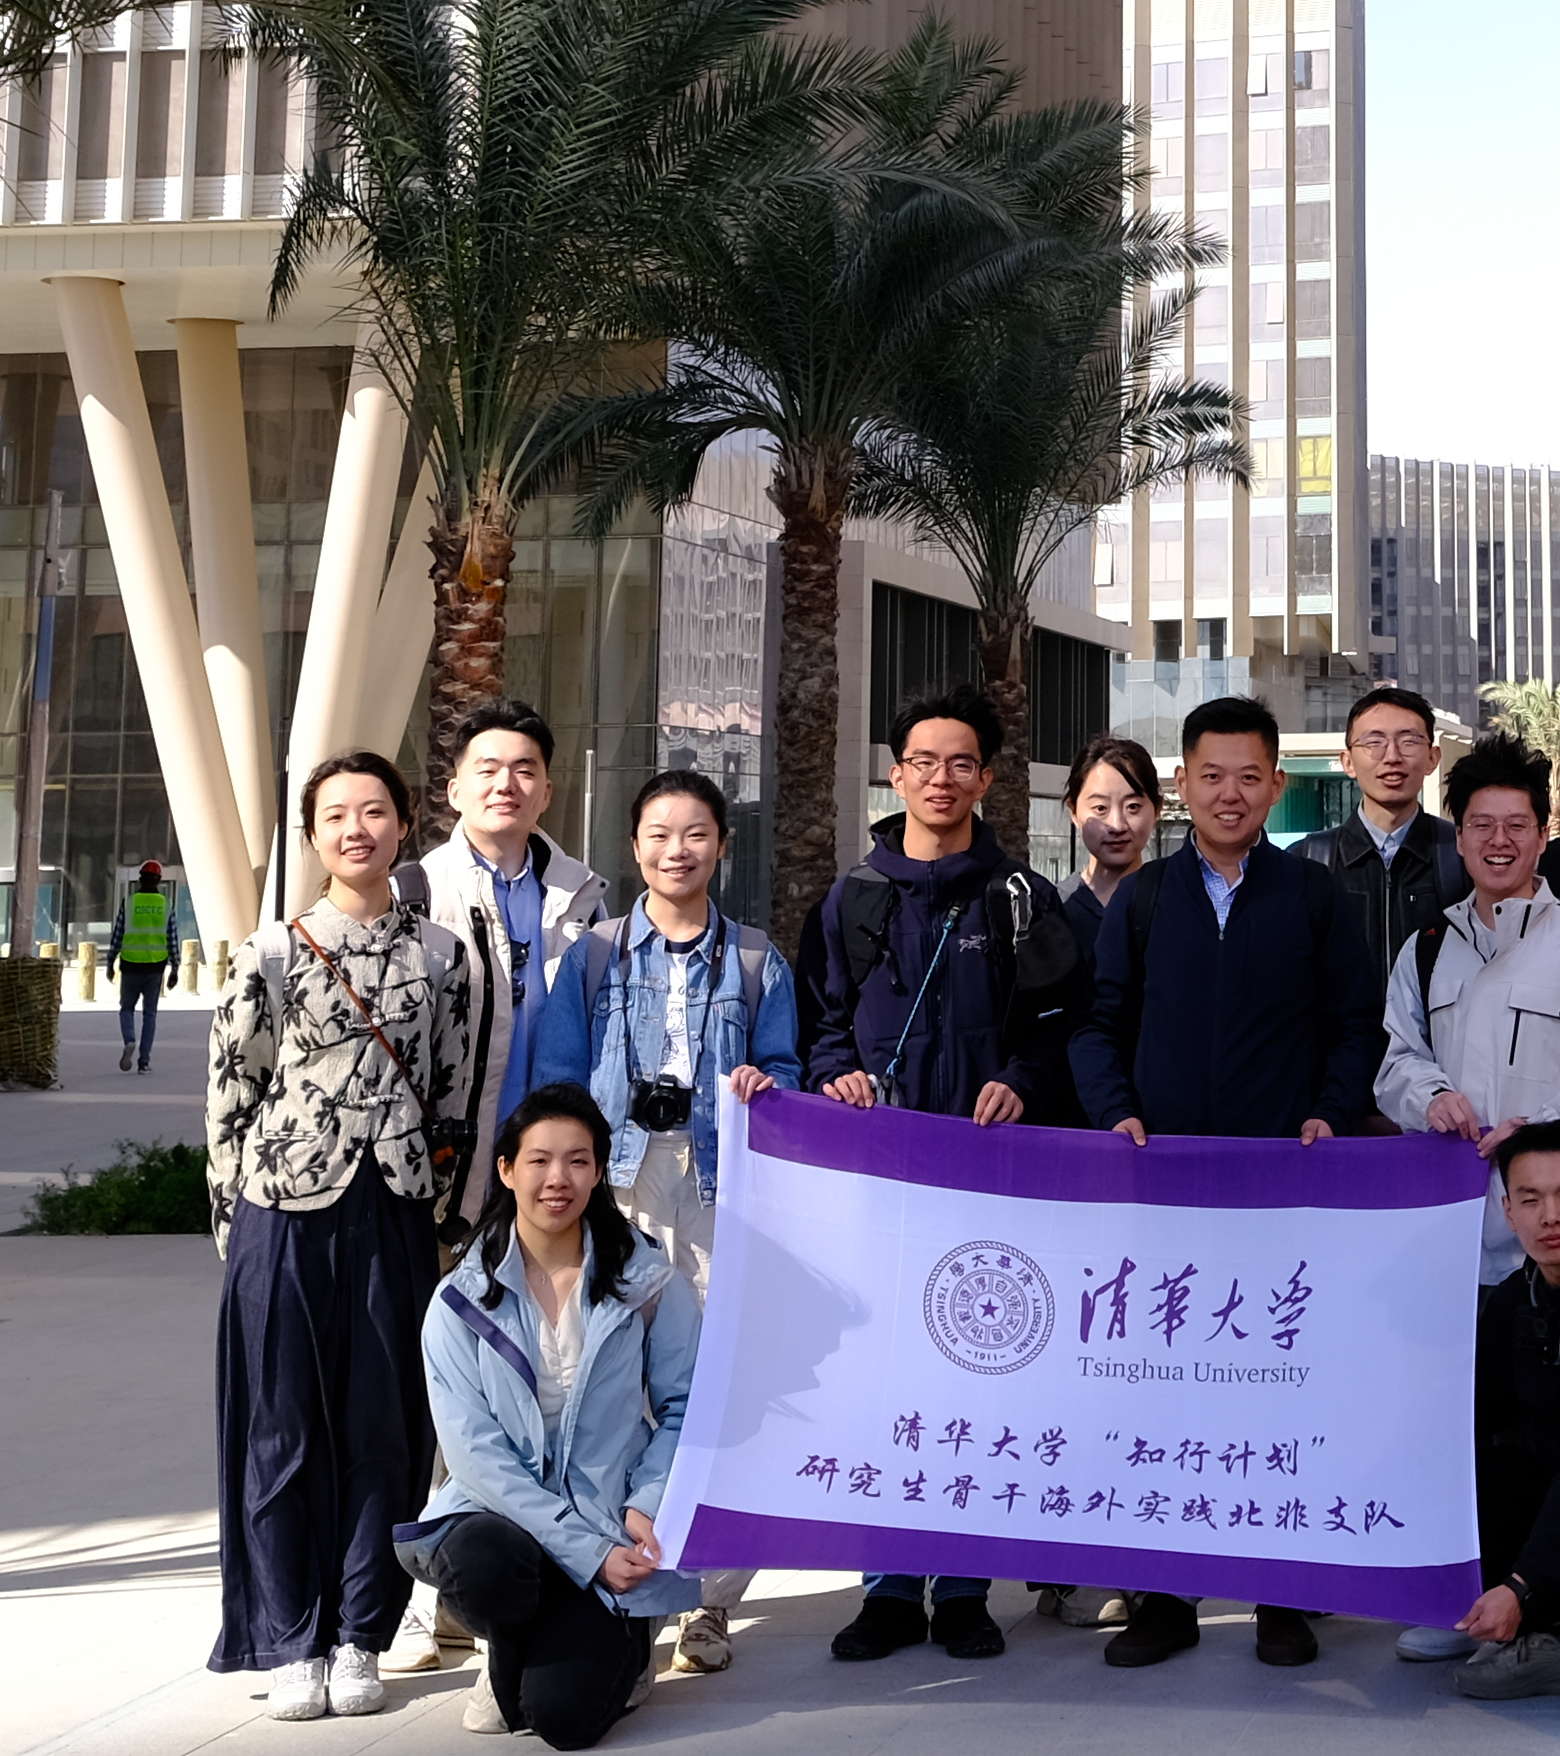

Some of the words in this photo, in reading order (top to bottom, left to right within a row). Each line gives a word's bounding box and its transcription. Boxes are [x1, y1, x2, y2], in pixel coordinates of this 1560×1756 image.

[1077, 1356, 1185, 1385] Tsinghua
[1193, 1361, 1311, 1388] University
[795, 1454, 1406, 1536] 研究生骨干海外实践北非支队
